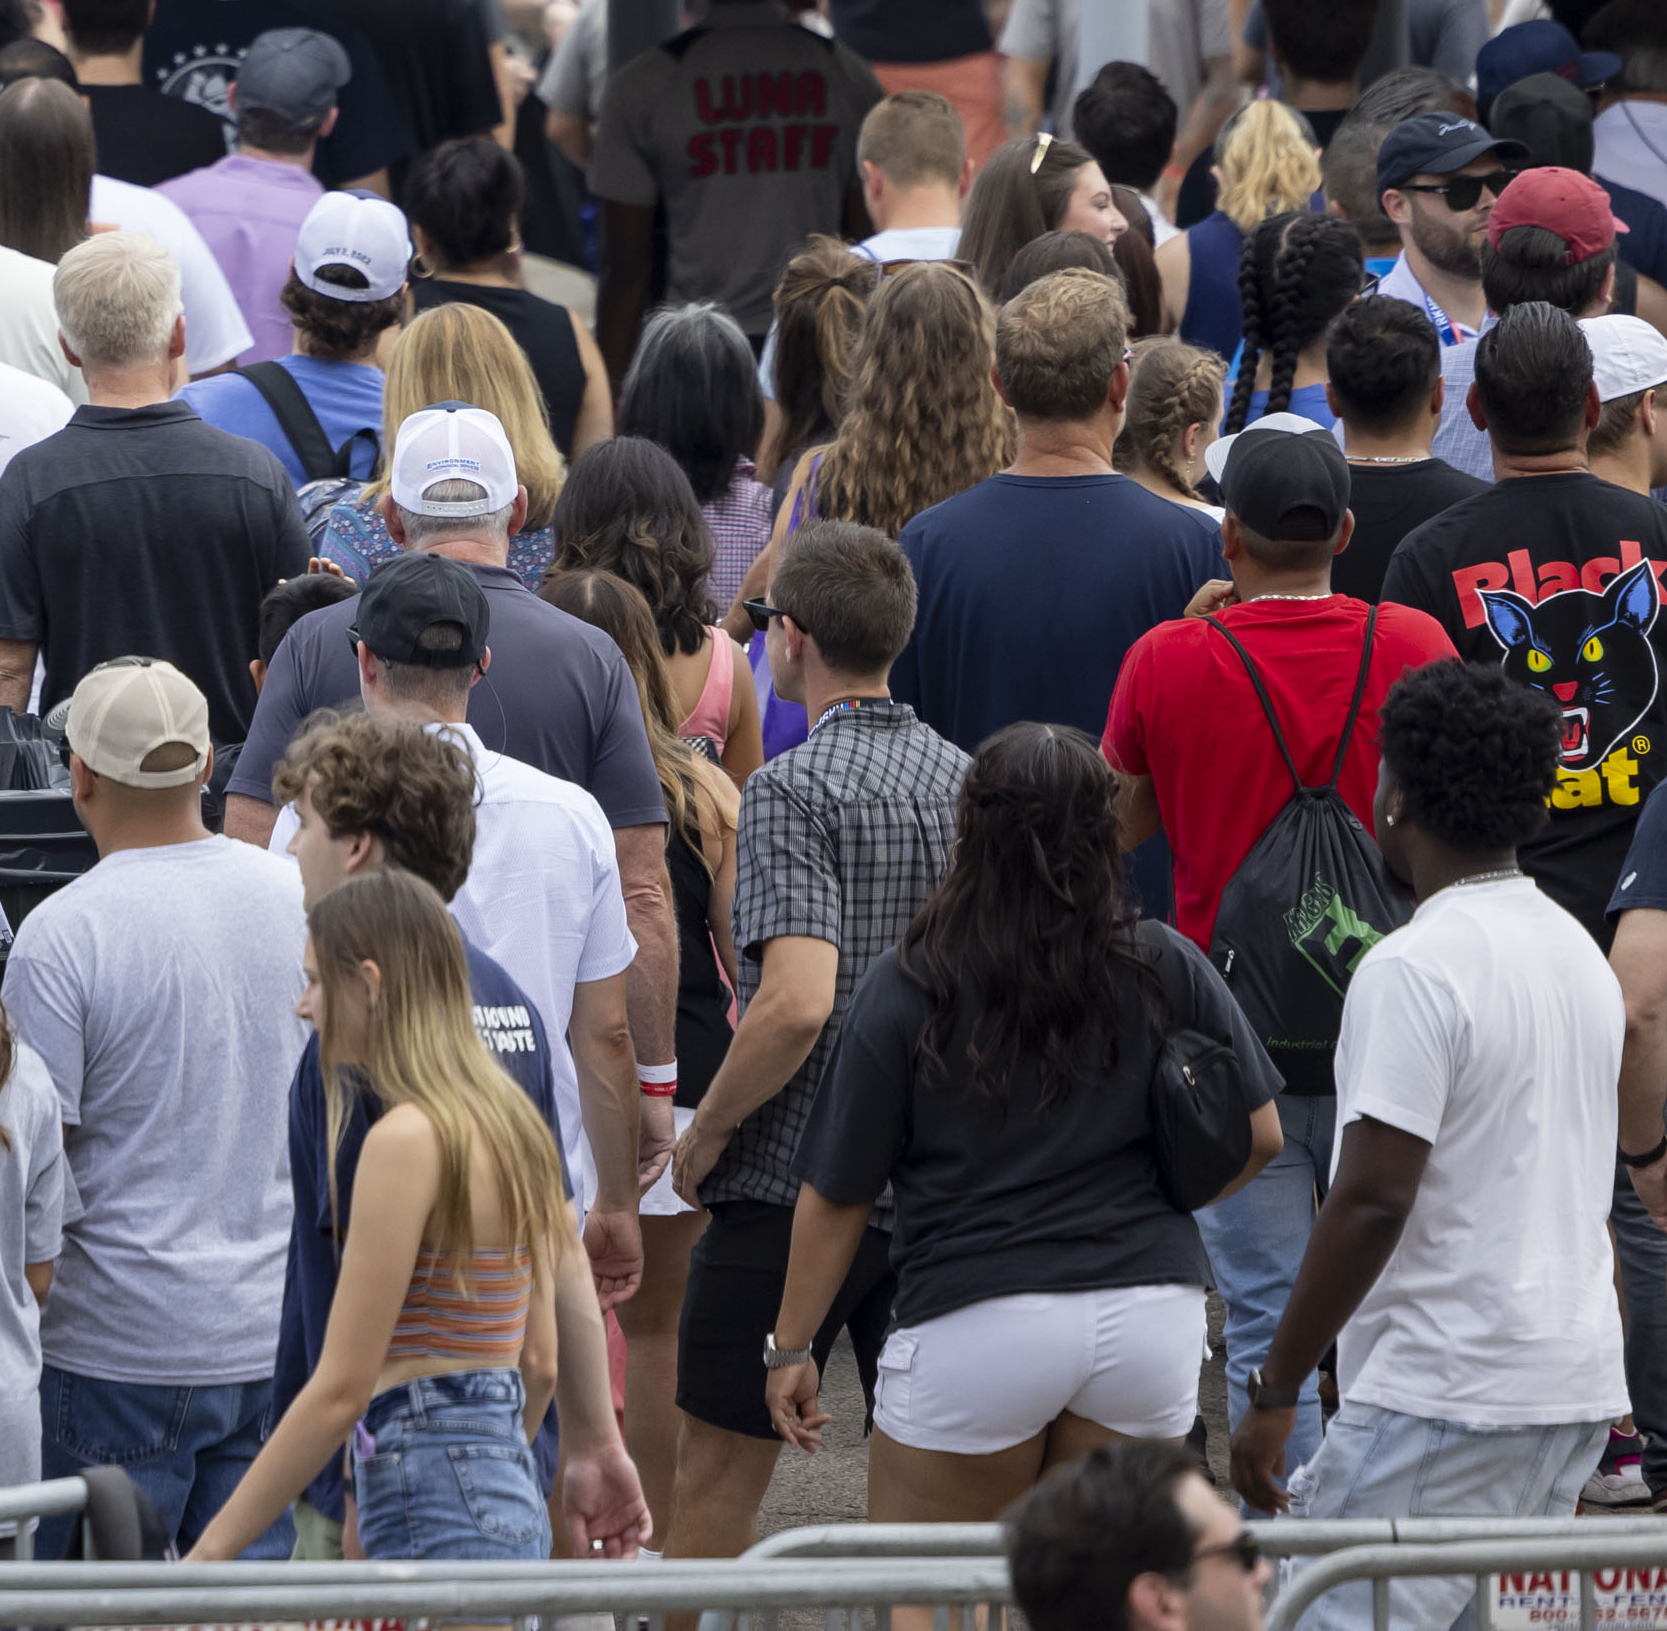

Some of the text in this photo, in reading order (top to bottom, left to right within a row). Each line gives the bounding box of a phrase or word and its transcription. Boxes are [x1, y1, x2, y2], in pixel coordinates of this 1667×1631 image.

[694, 69, 828, 125] LUNA
[688, 124, 840, 179] STAFF
[1451, 540, 1667, 630] Black
[1545, 746, 1640, 809] at
[1266, 1035, 1329, 1051] Industrial
